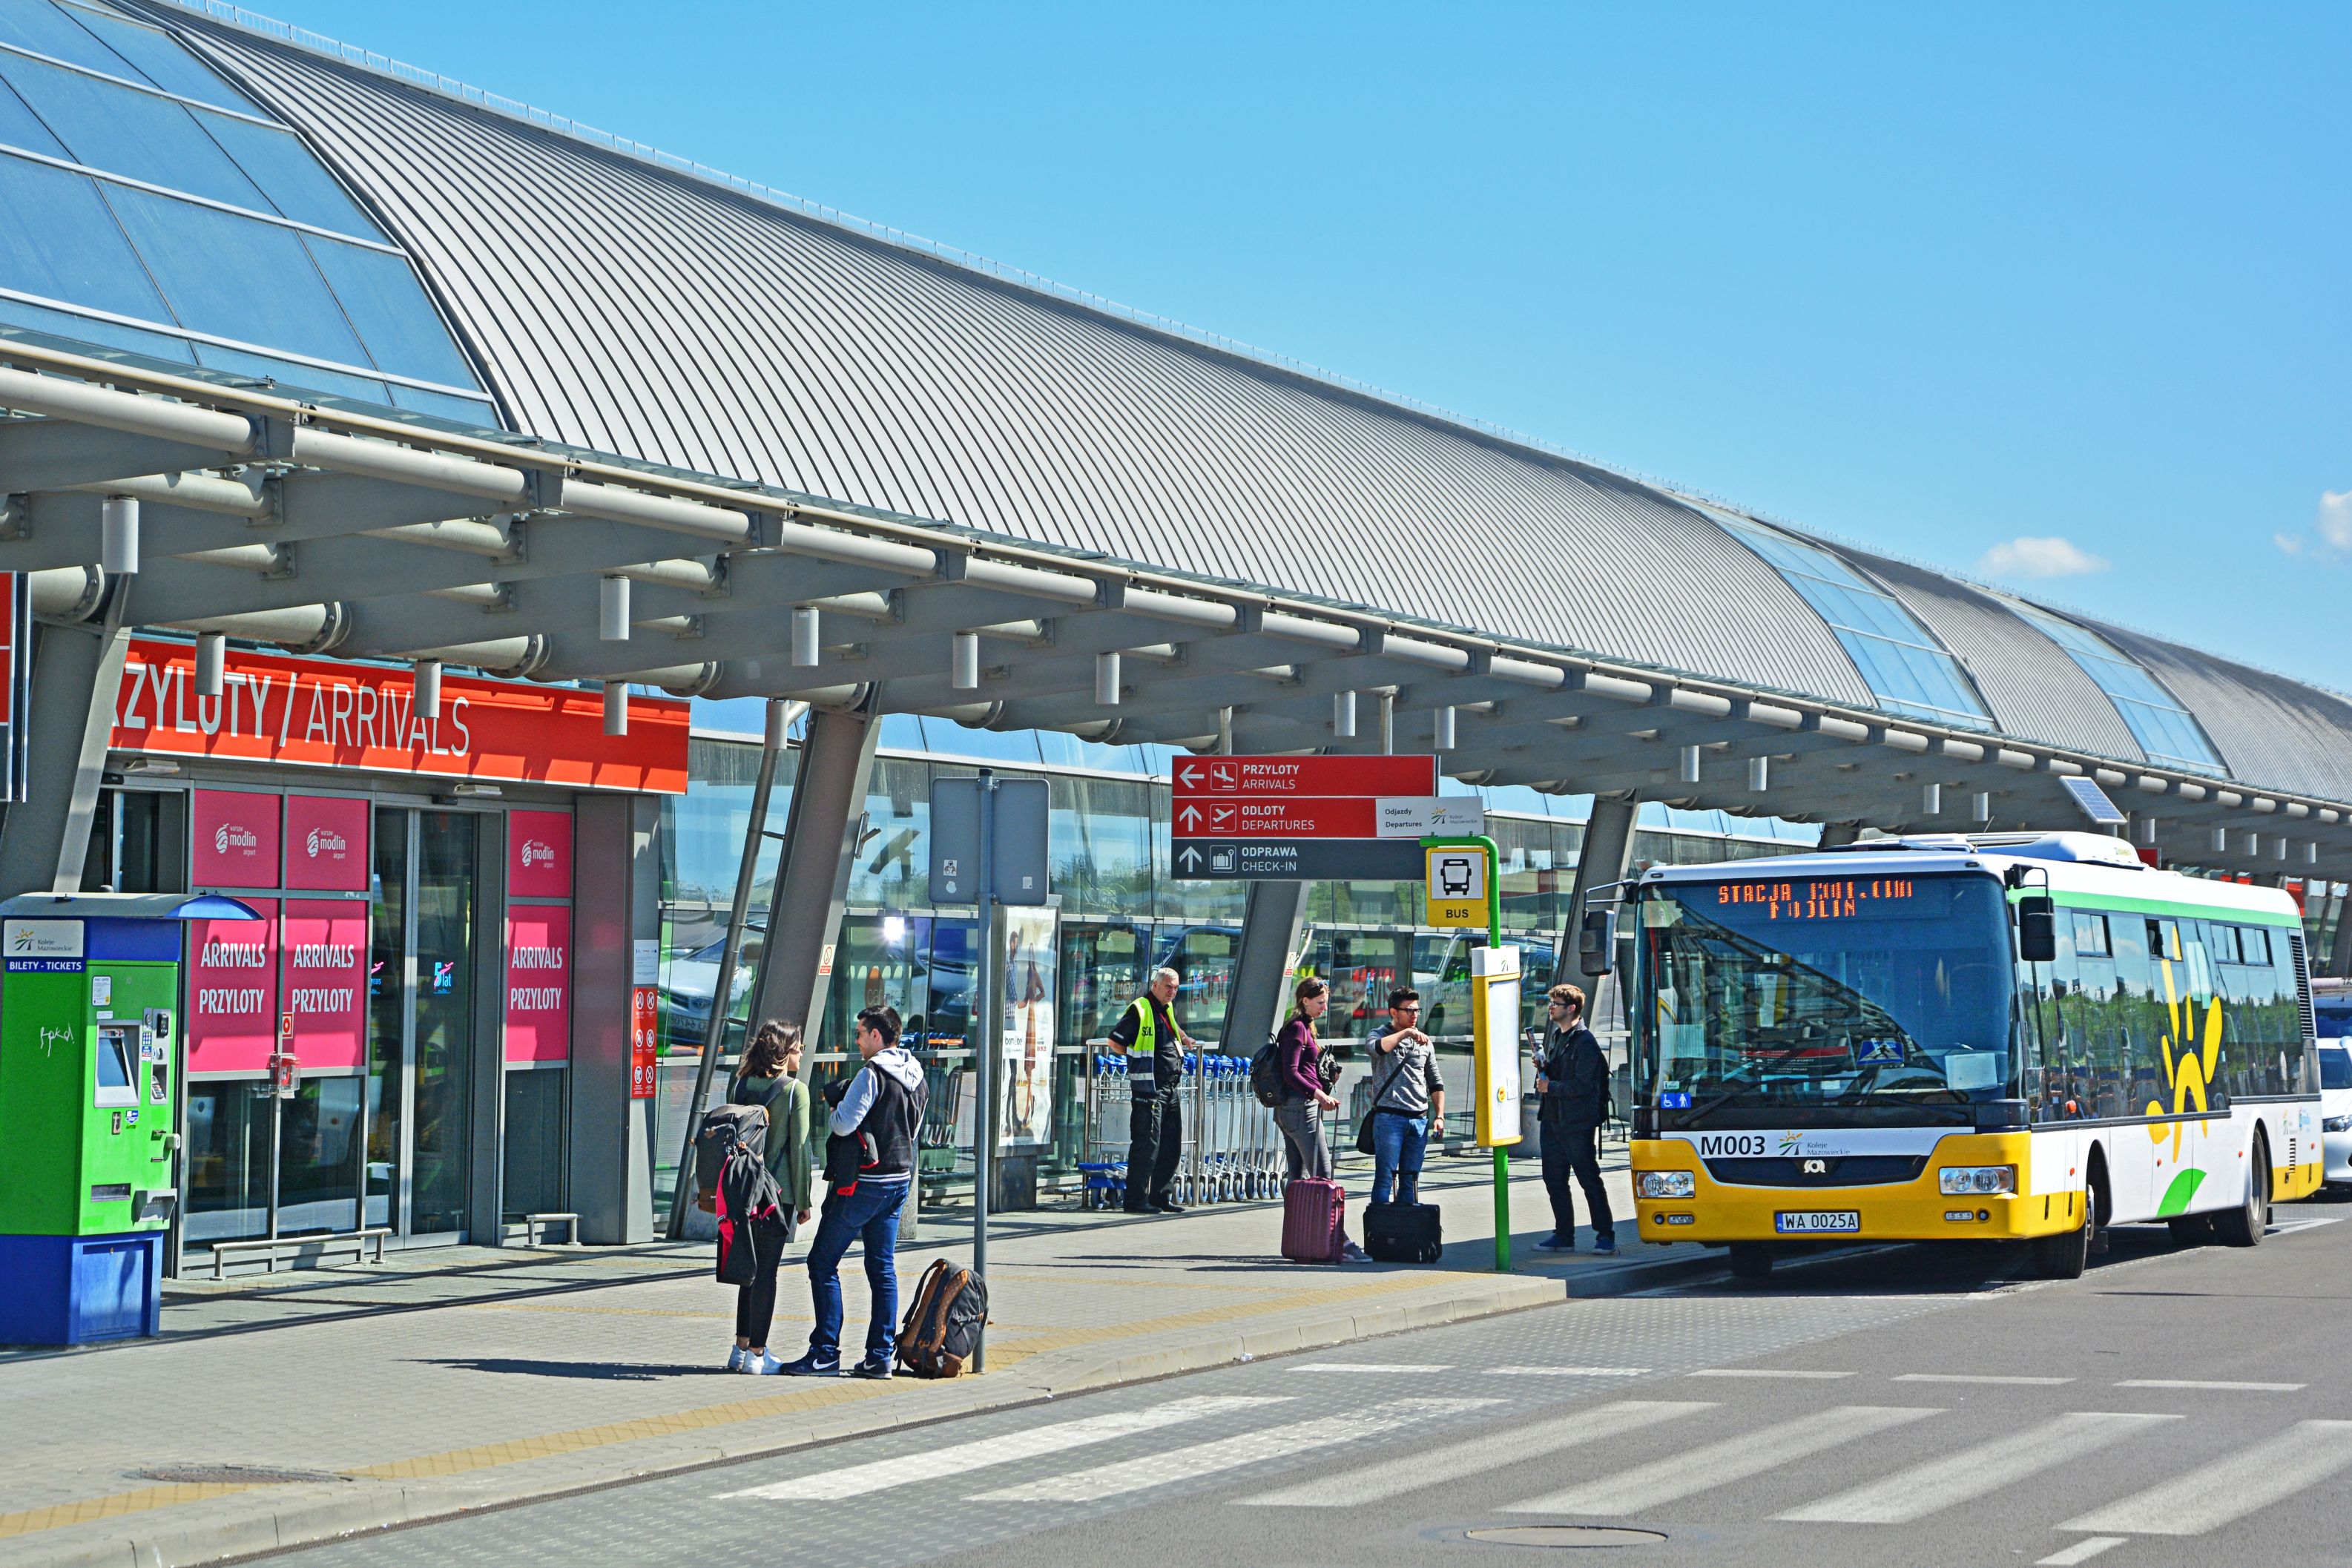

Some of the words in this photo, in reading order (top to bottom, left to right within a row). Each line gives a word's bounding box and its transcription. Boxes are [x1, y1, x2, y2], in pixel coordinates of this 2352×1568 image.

[112, 662, 271, 739] ZYLOTY
[305, 681, 470, 757] ARRIVALS
[1242, 765, 1299, 775] PRZYLOTY
[1242, 780, 1296, 790] ARRIVALS
[1242, 806, 1285, 816] ODLOTY
[1242, 820, 1315, 830] DEPARTURES
[229, 831, 256, 847] modlin
[320, 834, 346, 851] modlin
[243, 849, 256, 857] airport
[533, 846, 554, 860] modlin
[1242, 847, 1298, 857] ODPRAWA
[1242, 861, 1297, 872] CHECK-IN
[1719, 883, 1791, 903] STACJA
[1446, 909, 1469, 918] BUS
[201, 943, 266, 968] ARRIVALS
[293, 944, 355, 968] ARRIVALS
[512, 946, 563, 969] ARRIVALS
[10, 961, 39, 971] BILETY
[46, 961, 82, 971] TICKETS
[199, 989, 265, 1013] PRZYLOTY
[291, 989, 354, 1012] PRZYLOTY
[511, 987, 562, 1009] PRZYLOTY
[1701, 1136, 1765, 1156] M003
[1785, 1214, 1806, 1228] WA
[1811, 1213, 1857, 1228] 0025A
